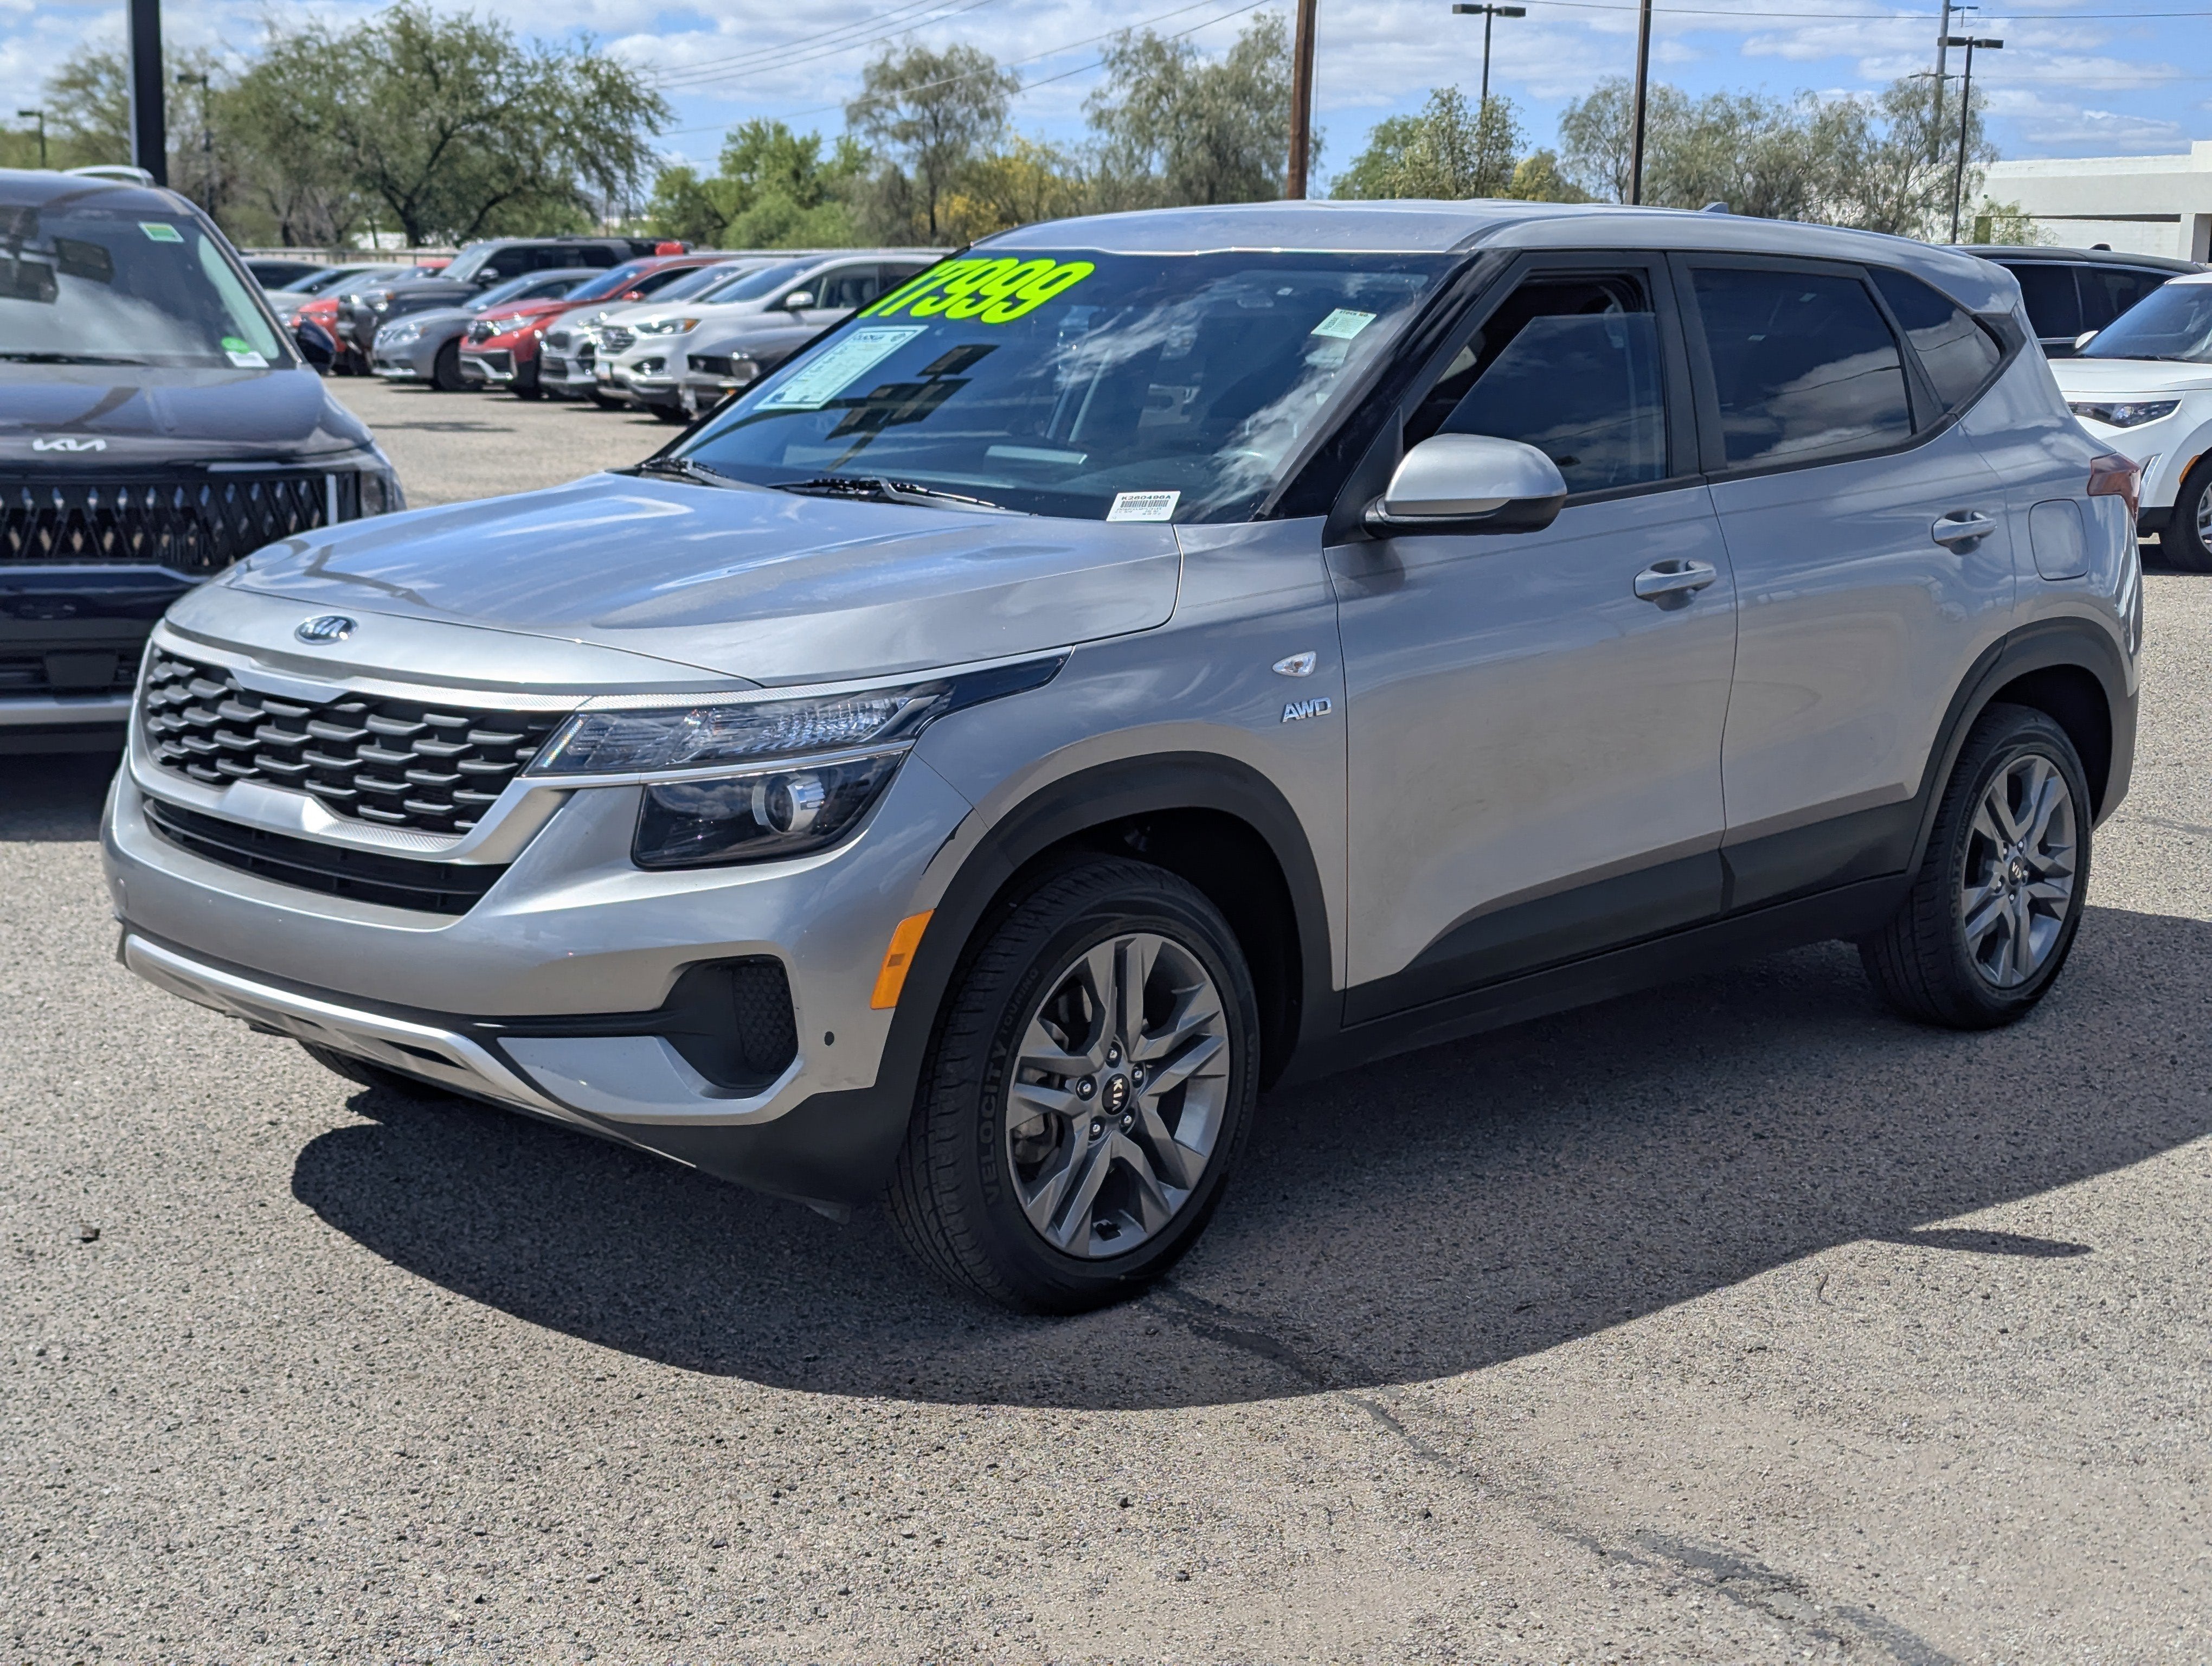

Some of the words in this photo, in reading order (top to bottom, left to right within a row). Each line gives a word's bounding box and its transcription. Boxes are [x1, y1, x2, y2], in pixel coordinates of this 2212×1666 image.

[858, 257, 1096, 324] 17999
[300, 617, 347, 638] KIA
[1281, 697, 1332, 723] AWD
[1112, 1078, 1123, 1112] KIA
[979, 1047, 1007, 1204] VELOCITY
